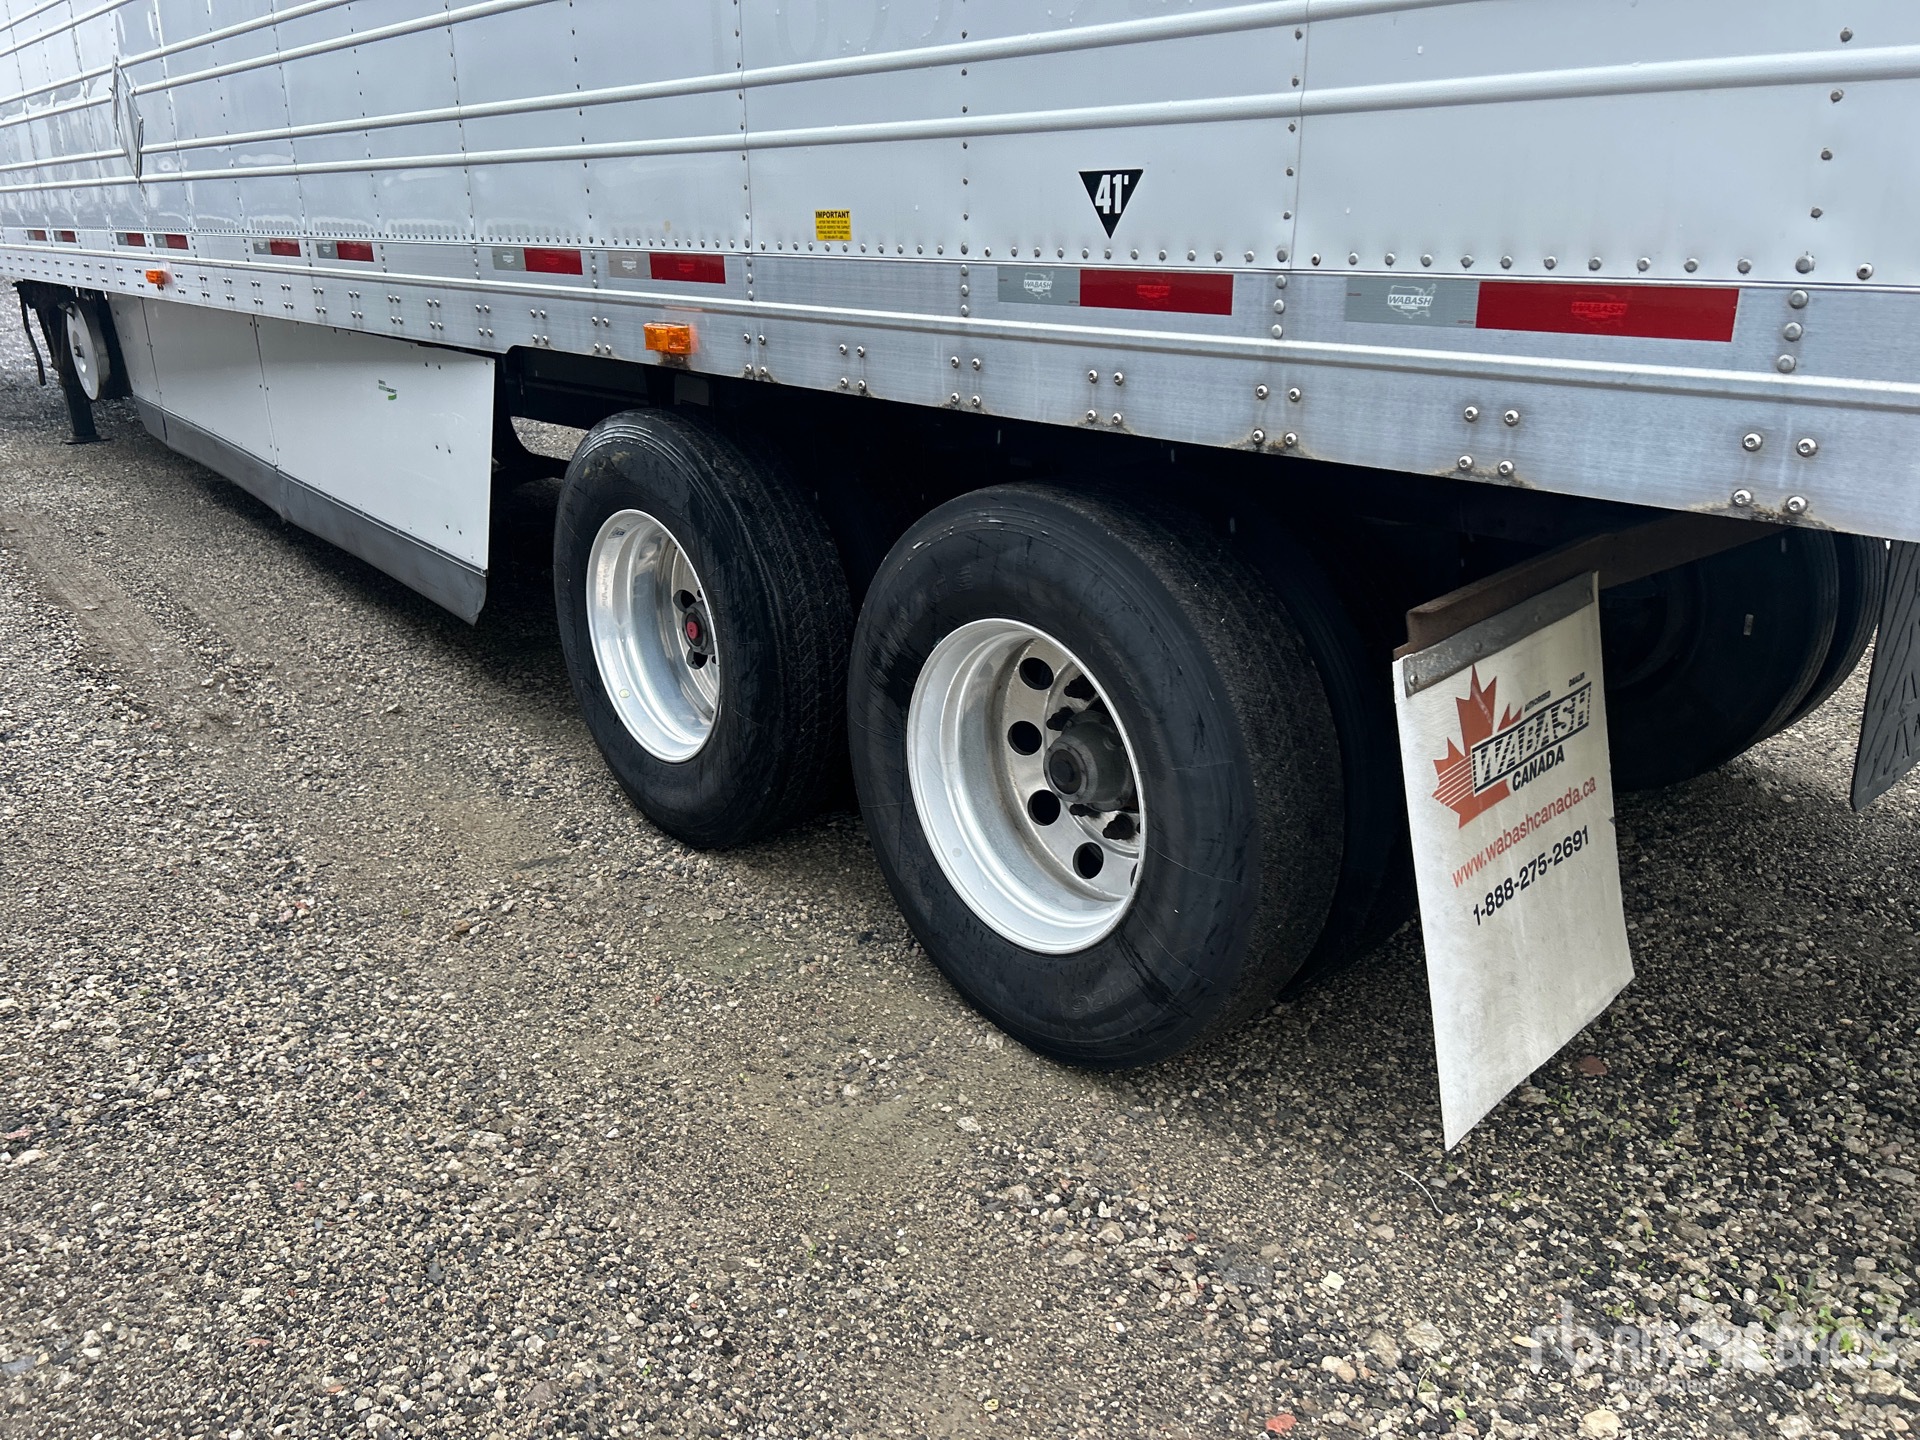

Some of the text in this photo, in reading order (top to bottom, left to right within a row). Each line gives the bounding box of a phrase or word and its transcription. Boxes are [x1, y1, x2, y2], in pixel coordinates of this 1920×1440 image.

[815, 211, 849, 219] IMPORTANT
[1024, 280, 1052, 289] WABASH
[1387, 296, 1432, 306] WABASH
[1472, 683, 1591, 794] WABASH
[1513, 745, 1565, 791] CANADA
[1452, 777, 1597, 888] www.wabashcanada.ca
[1473, 825, 1589, 926] 1-888-275-2691
